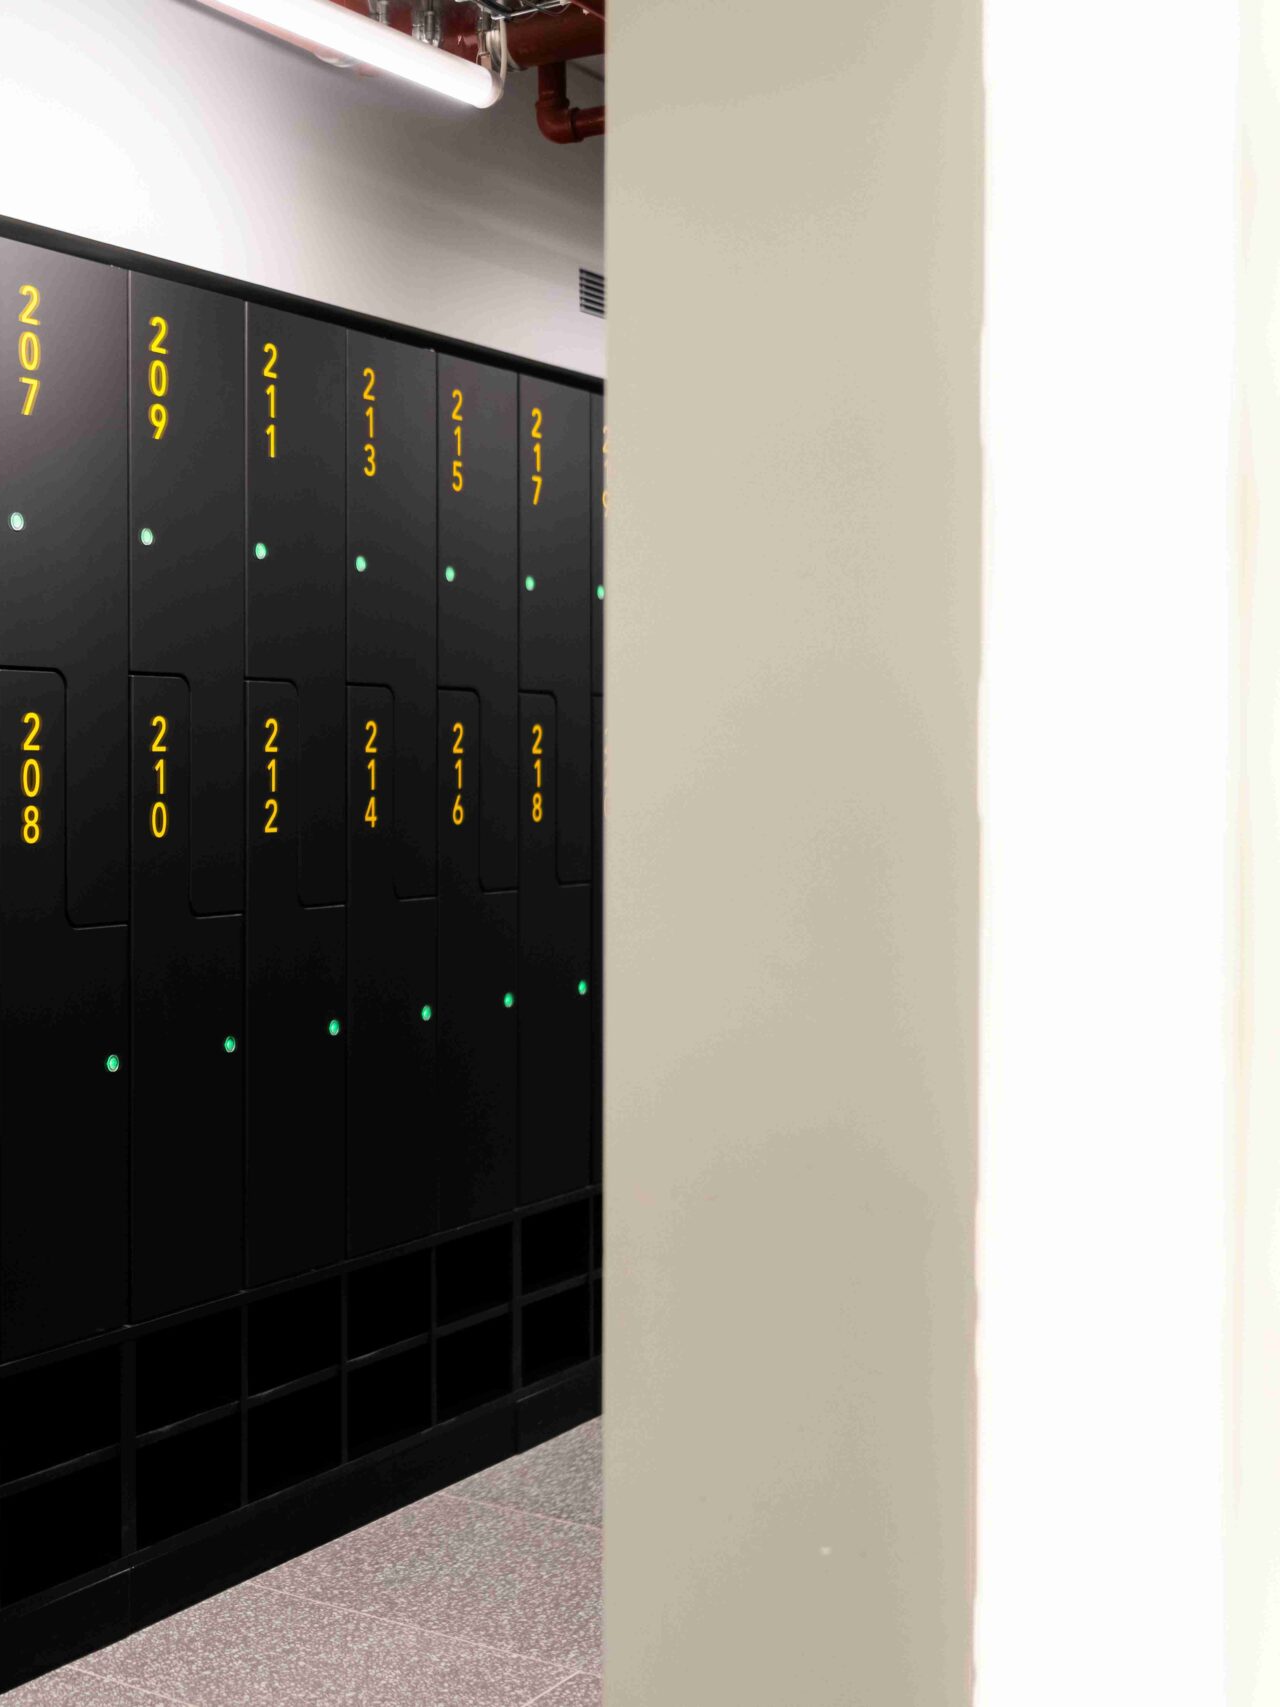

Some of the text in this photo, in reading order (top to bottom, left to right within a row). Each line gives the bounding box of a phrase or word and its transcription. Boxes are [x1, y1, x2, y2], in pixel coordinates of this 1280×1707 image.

[17, 284, 42, 417] 207
[146, 315, 171, 441] 209
[261, 342, 279, 459] 211
[361, 367, 378, 478] 213
[449, 388, 465, 493] 215
[529, 406, 544, 506] 217
[21, 711, 42, 845] 208
[150, 715, 169, 839] 210
[263, 717, 280, 834] 212
[363, 720, 379, 828] 214
[451, 722, 465, 826] 216
[530, 723, 544, 823] 218
